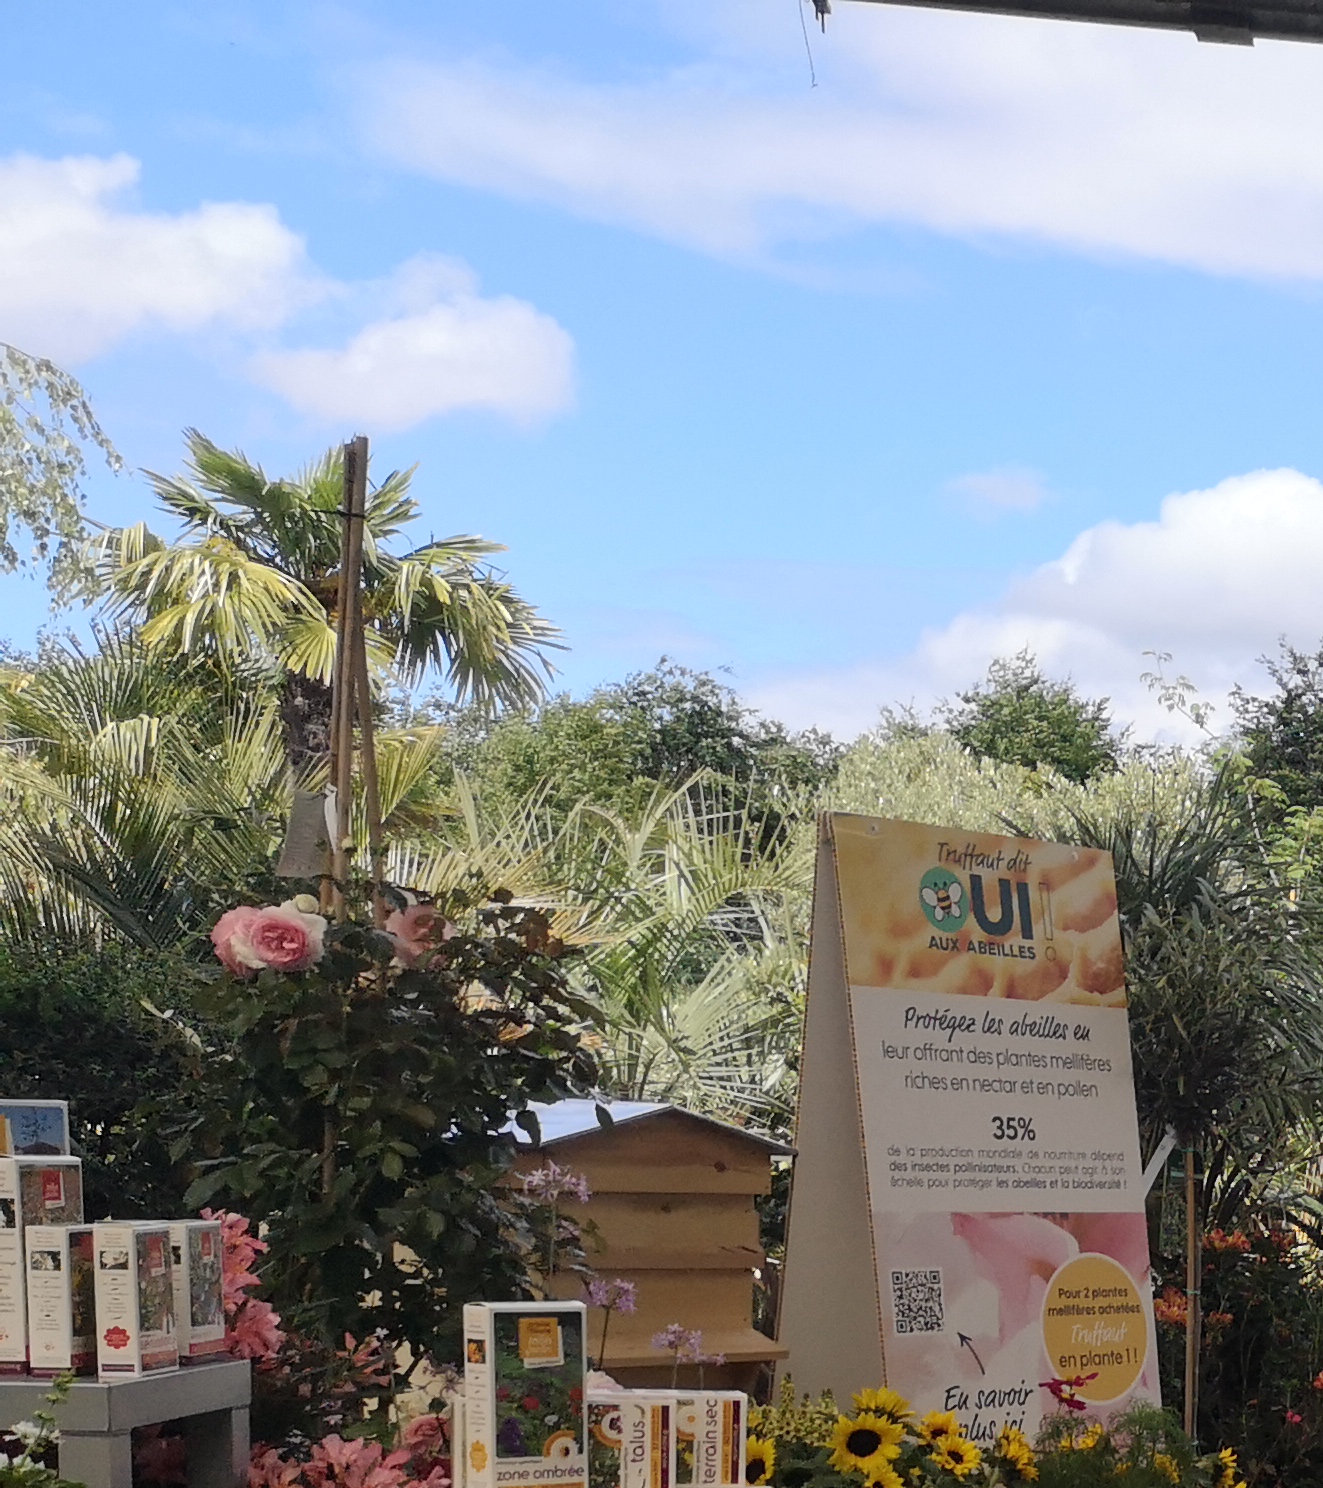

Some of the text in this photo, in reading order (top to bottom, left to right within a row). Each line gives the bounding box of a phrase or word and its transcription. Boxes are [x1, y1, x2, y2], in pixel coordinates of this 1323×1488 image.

[937, 842, 1033, 873] Truffaut dit
[928, 935, 1036, 960] AUX ABEILLES
[904, 1006, 1091, 1043] Protégez les abeilles en
[881, 1040, 1112, 1073] leur offrant des plantes mellifères
[904, 1070, 1099, 1100] riches en nectar et en pollen
[991, 1116, 1036, 1141] 35%
[887, 1144, 1125, 1162] de la production mondiale de nourriture dépend
[889, 1160, 907, 1172] des
[911, 1160, 950, 1173] insectes
[954, 1161, 1019, 1174] pollinisateurs.
[1022, 1162, 1055, 1174] Chacun
[1059, 1164, 1079, 1176] peut
[1082, 1165, 1098, 1178] agir
[1110, 1166, 1126, 1176] son
[890, 1175, 924, 1188] échelle
[927, 1177, 949, 1190] pour
[953, 1177, 992, 1191] protéger
[996, 1176, 1009, 1189] les
[1011, 1177, 1047, 1189] abeilles
[1049, 1178, 1058, 1189] et
[1061, 1178, 1070, 1189] la
[1072, 1178, 1121, 1190] biodiversité
[1058, 1286, 1128, 1301] Pour 2 plantes
[1048, 1302, 1141, 1317] mellifères achetées
[1071, 1321, 1128, 1346] Truffaut
[1059, 1355, 1077, 1368] en
[1080, 1349, 1124, 1371] plante
[944, 1379, 1034, 1411] En savoir
[630, 1420, 646, 1464] talus
[703, 1399, 719, 1485] terrain sec
[497, 1465, 585, 1481] zone ombrée
